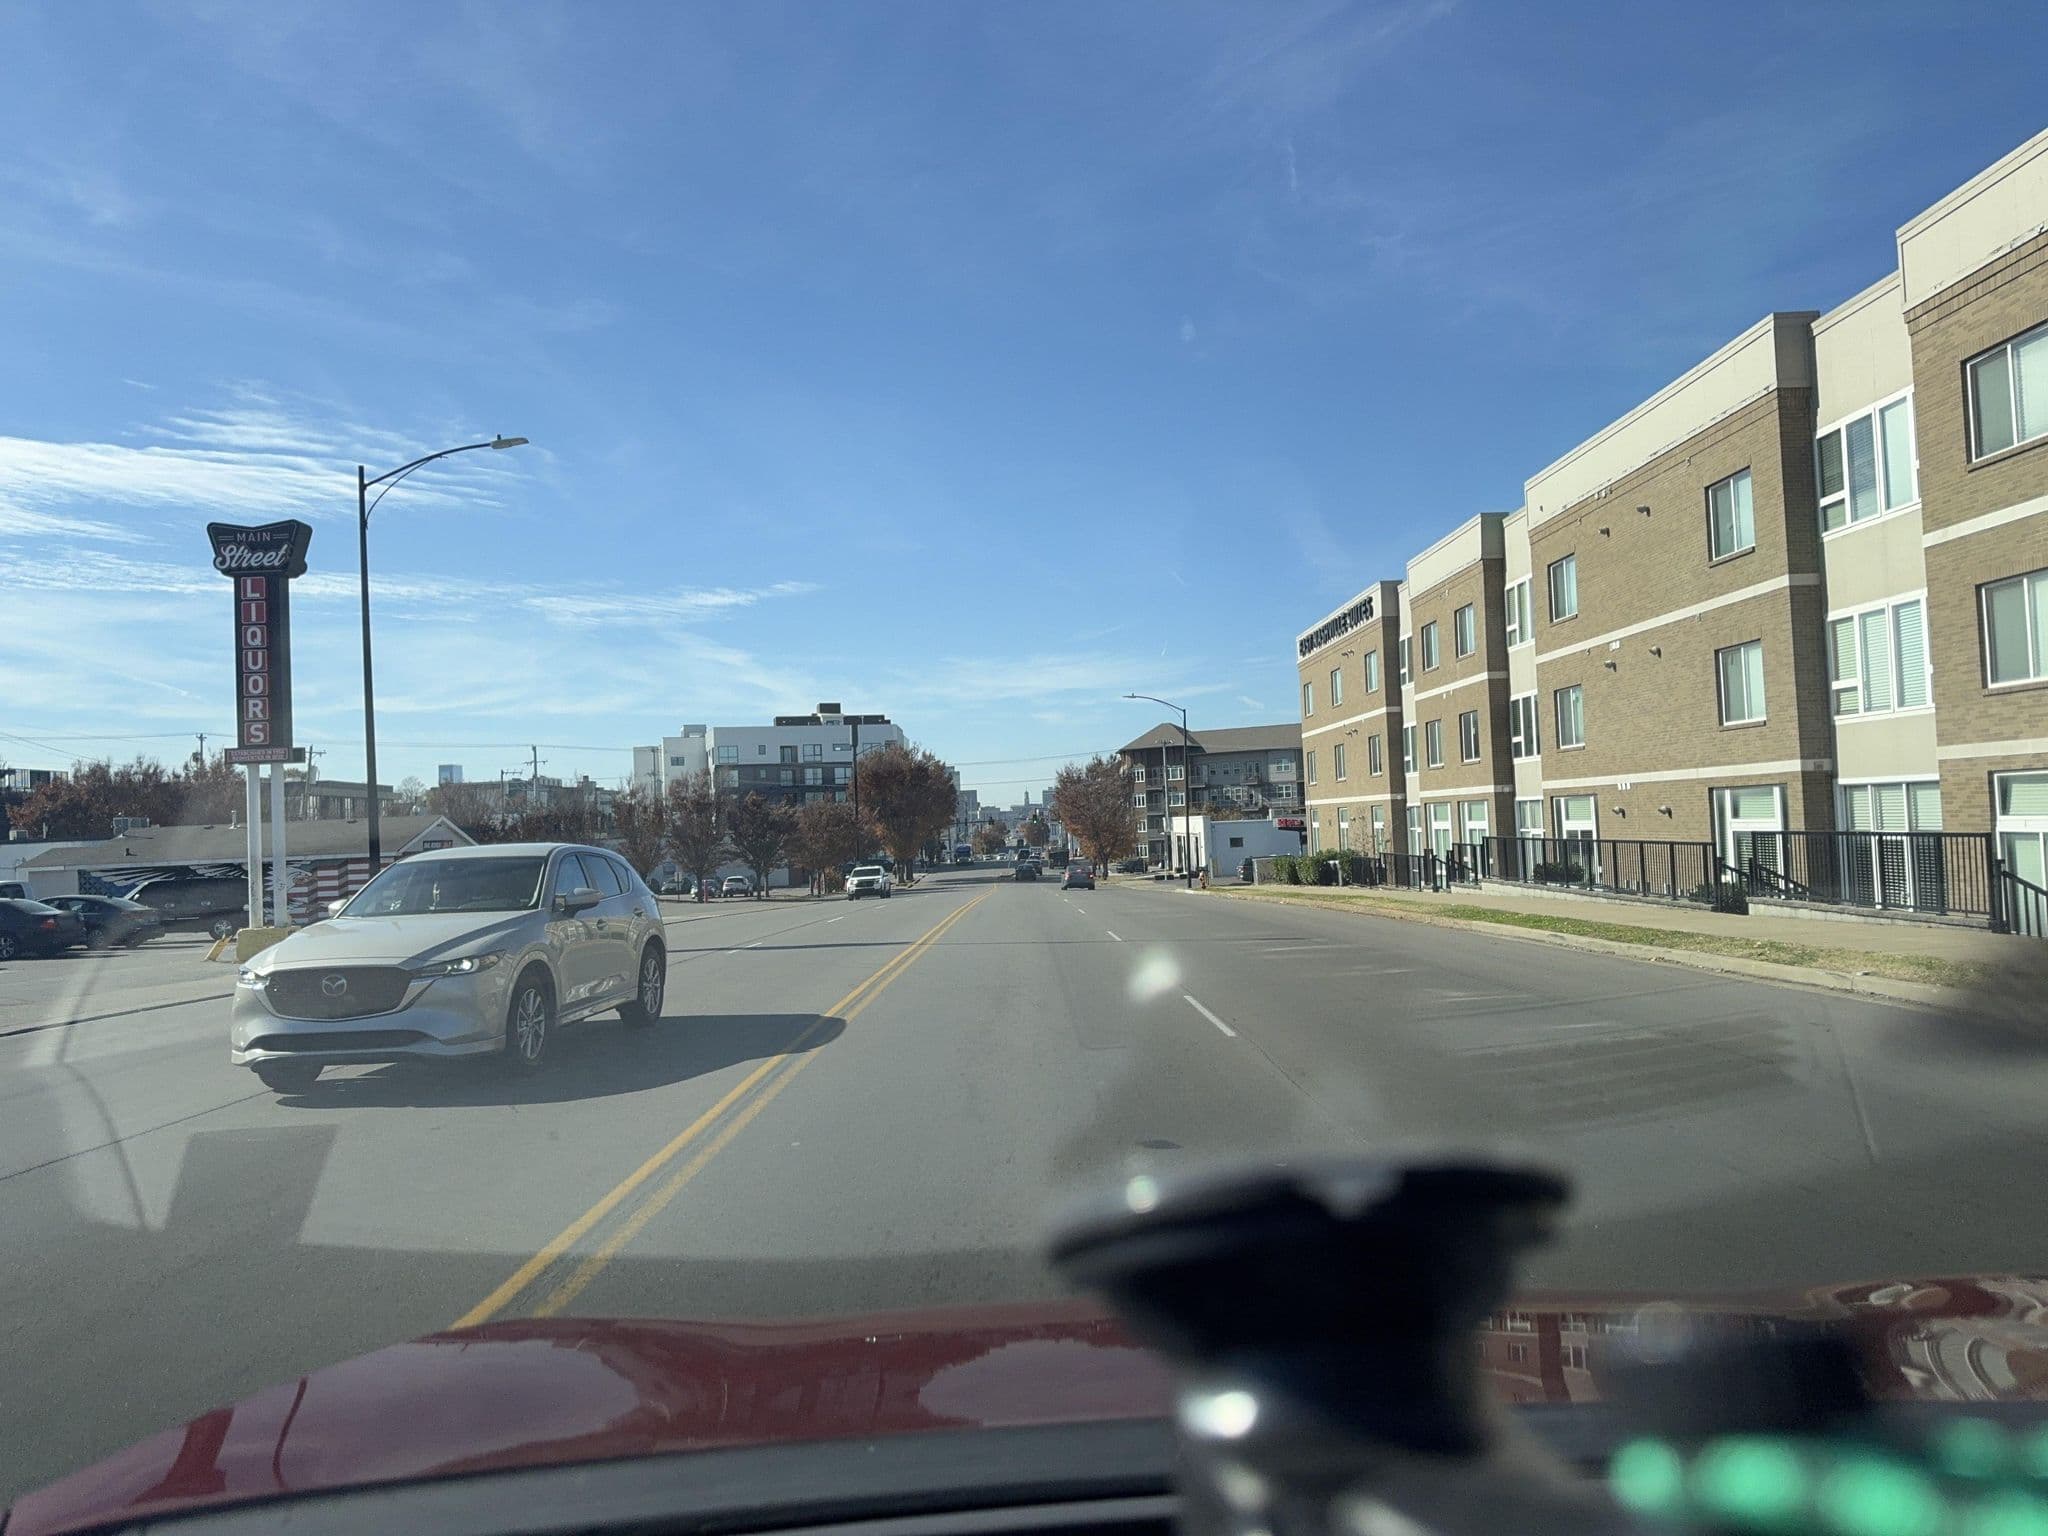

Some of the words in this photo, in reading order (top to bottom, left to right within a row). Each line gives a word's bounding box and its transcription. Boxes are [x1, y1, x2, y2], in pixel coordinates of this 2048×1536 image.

[215, 544, 288, 569] Street
[237, 532, 271, 542] MAIN
[1299, 633, 1313, 658] EAST
[1313, 611, 1348, 650] NASHVILLE
[1348, 596, 1374, 631] SUITES
[246, 577, 265, 744] LIQUORS
